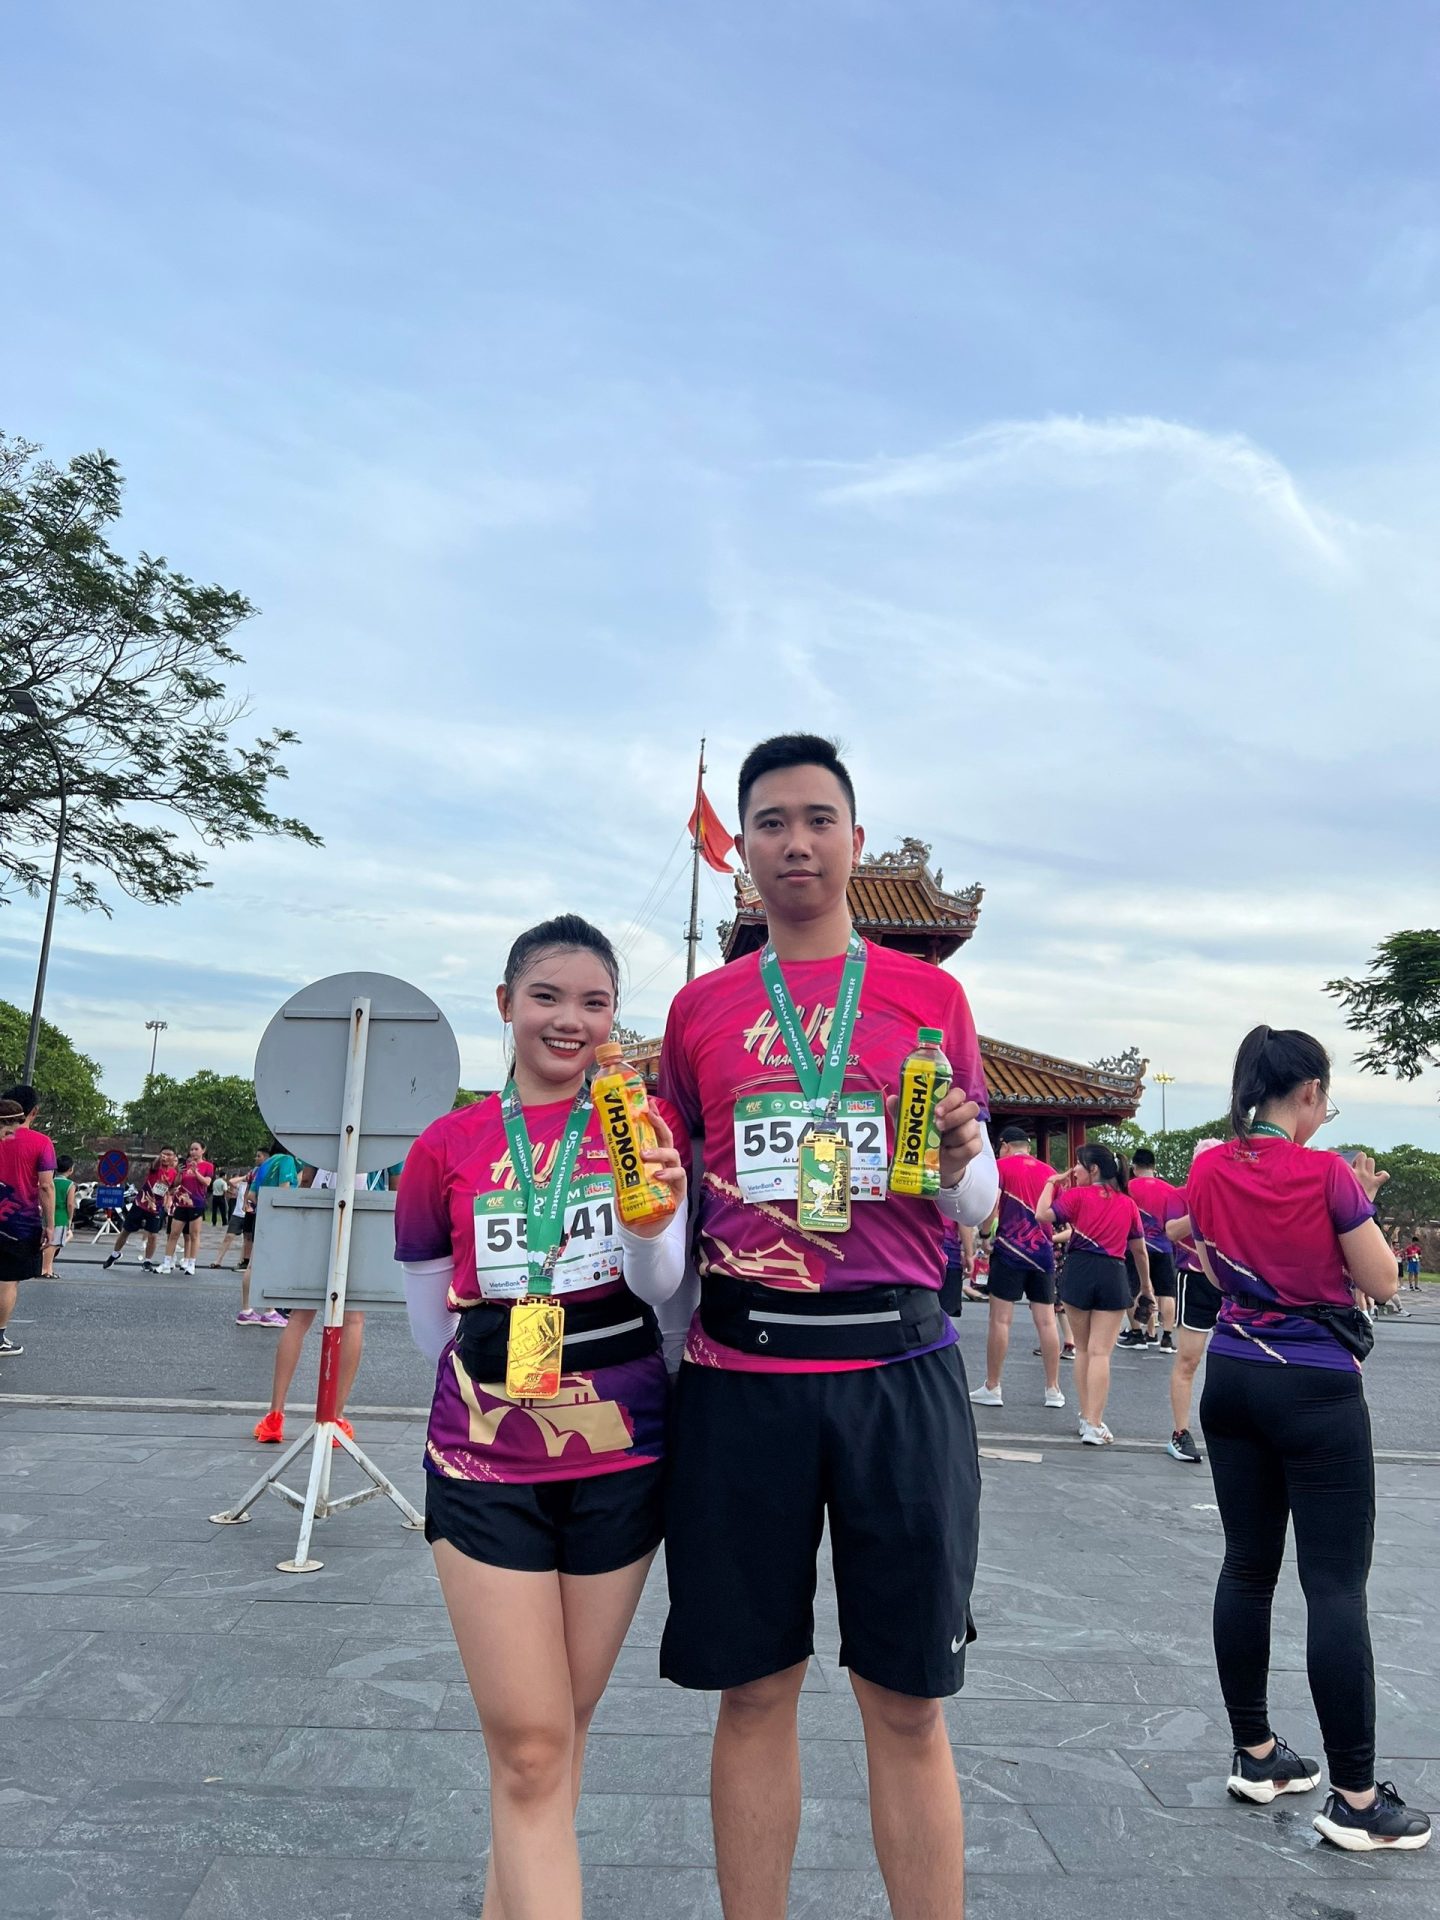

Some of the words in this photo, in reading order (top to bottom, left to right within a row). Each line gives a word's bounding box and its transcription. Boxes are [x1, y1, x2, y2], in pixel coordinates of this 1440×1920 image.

[773, 984, 789, 1020] 05KM
[786, 1021, 808, 1070] FINISHER
[830, 1027, 846, 1067] 05KM
[841, 978, 856, 1026] FINISHER
[515, 1133, 531, 1178] FINISHER
[562, 1130, 578, 1165] 05KM
[604, 1087, 640, 1188] BONCHA
[903, 1073, 928, 1166] BONCHA
[550, 1166, 566, 1219] FINISHER
